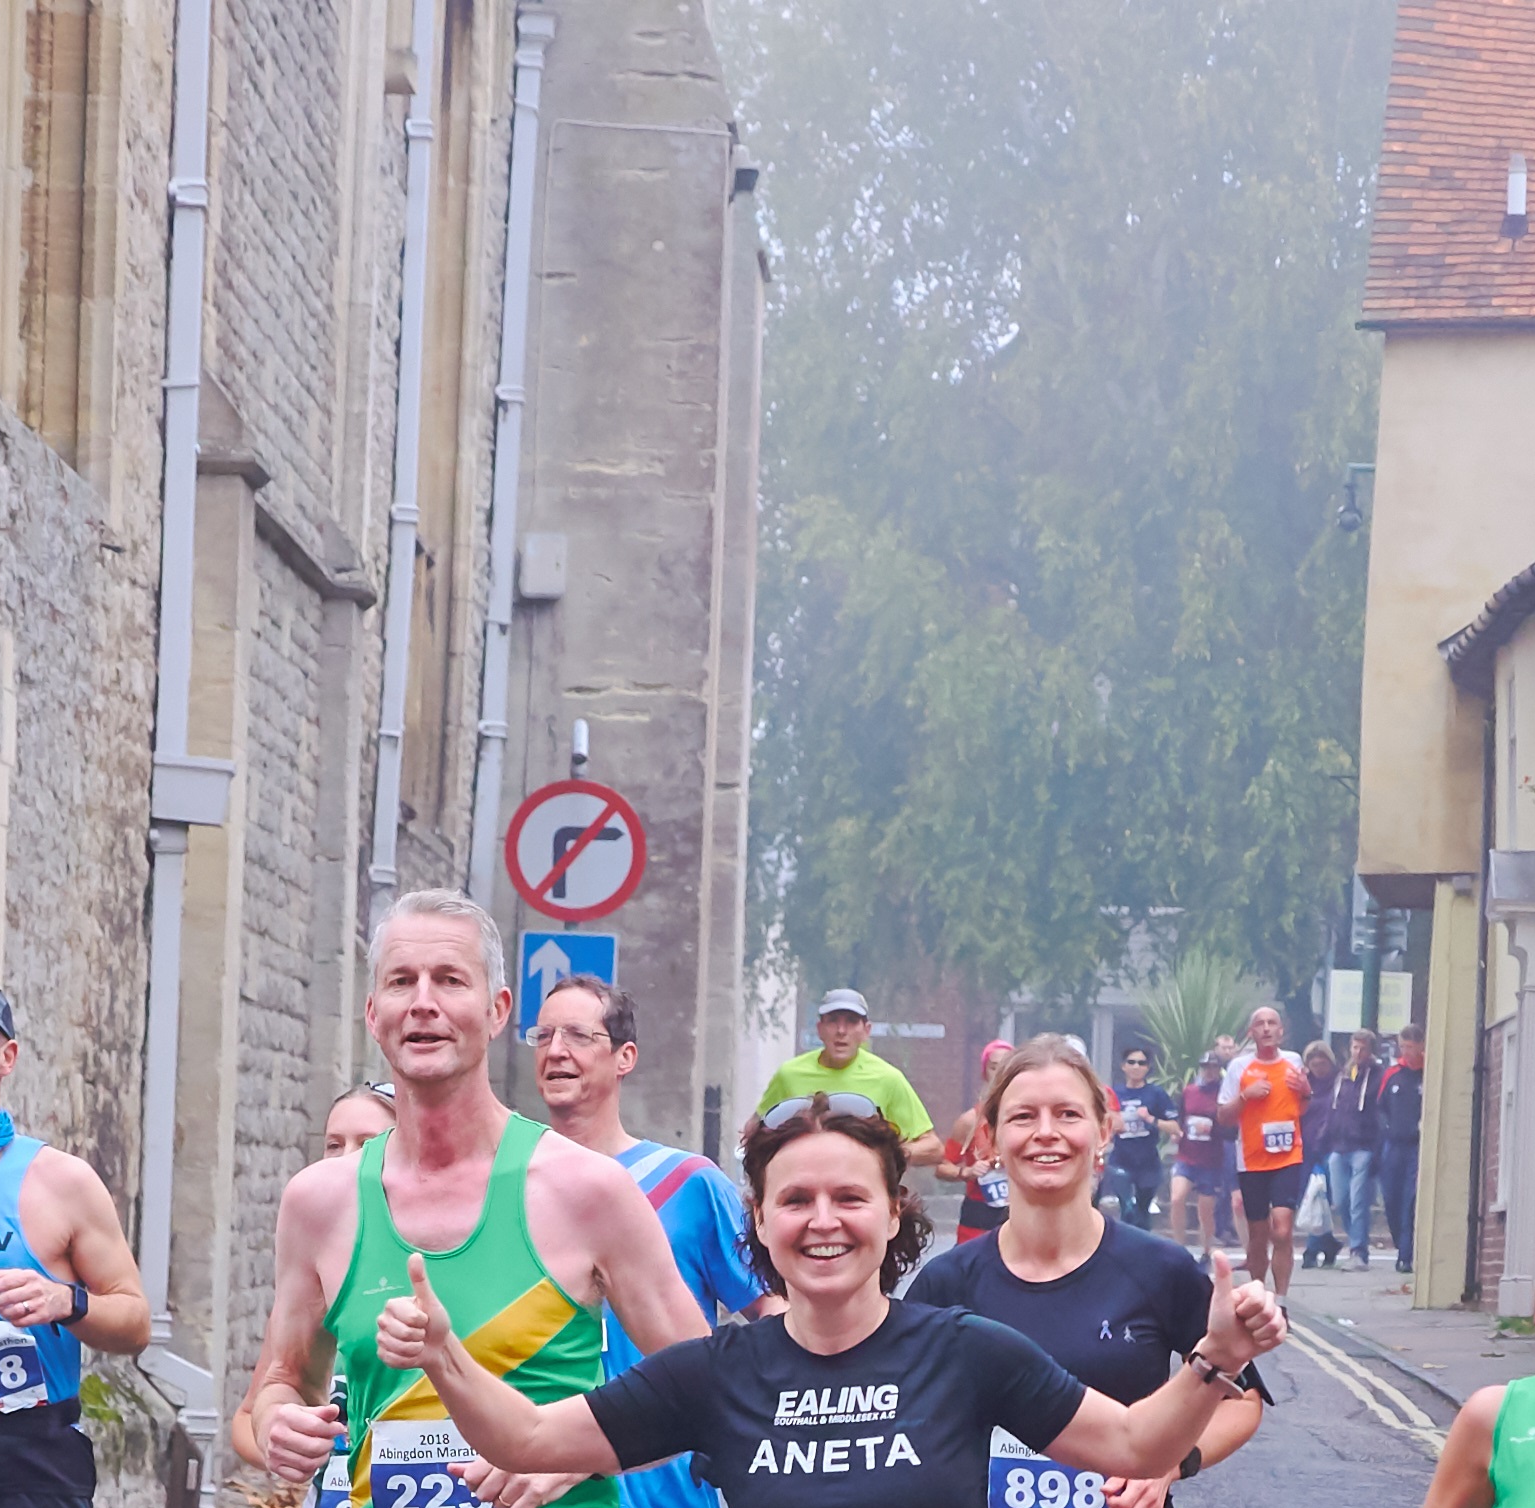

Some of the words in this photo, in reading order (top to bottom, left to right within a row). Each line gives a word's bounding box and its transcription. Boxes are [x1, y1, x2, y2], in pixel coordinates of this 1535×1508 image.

[987, 1181, 1009, 1200] 19
[775, 1384, 899, 1417] EALING
[774, 1415, 818, 1426] SOUTHALL
[828, 1411, 879, 1424] MIDDLESEX
[419, 1434, 450, 1446] 2018
[378, 1447, 433, 1462] Abingdon
[437, 1446, 479, 1458] Marat
[748, 1433, 922, 1475] ANETA
[999, 1443, 1040, 1458] Abing
